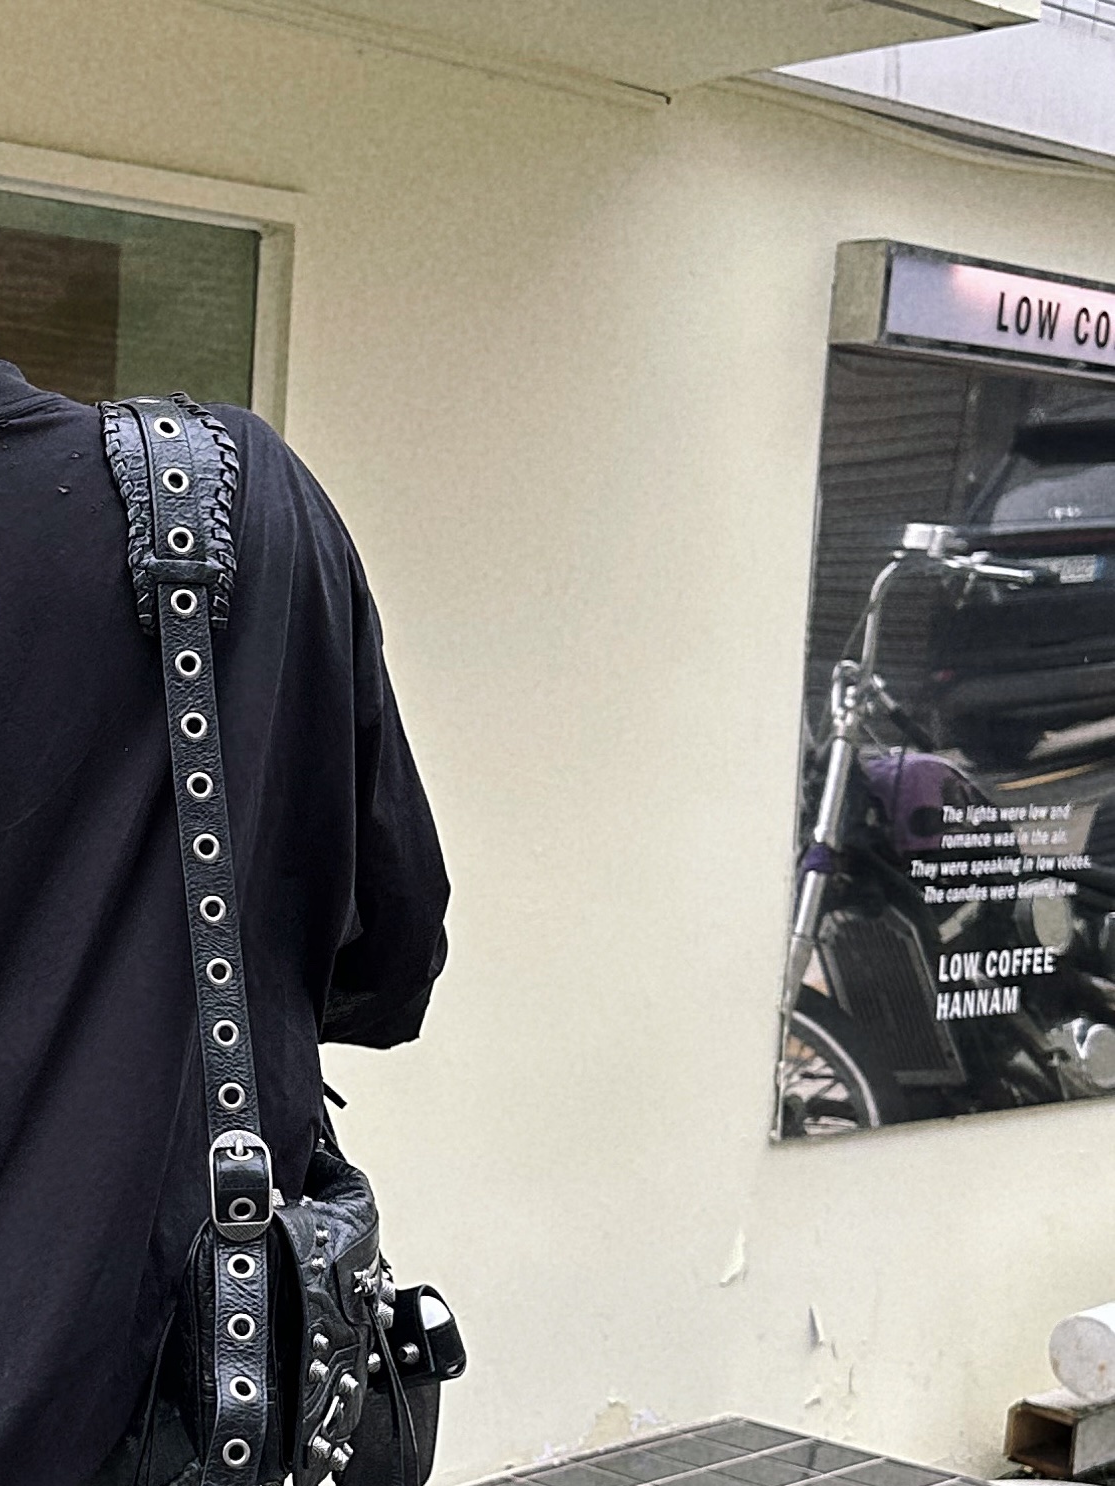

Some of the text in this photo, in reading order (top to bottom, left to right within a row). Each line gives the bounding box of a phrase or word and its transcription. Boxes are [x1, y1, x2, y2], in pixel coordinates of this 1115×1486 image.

[996, 291, 1115, 350] LOW CO
[942, 803, 1072, 826] The lights were low and
[941, 833, 992, 849] romance
[994, 832, 1016, 847] was
[911, 859, 939, 880] They
[940, 860, 968, 876] were
[970, 856, 1022, 878] speaking
[1022, 855, 1034, 872] in
[1035, 854, 1056, 872] low
[924, 885, 945, 904] The
[989, 884, 1016, 900] were
[938, 948, 1056, 982] LOW COFFEE
[936, 987, 1019, 1021] HANNAM
